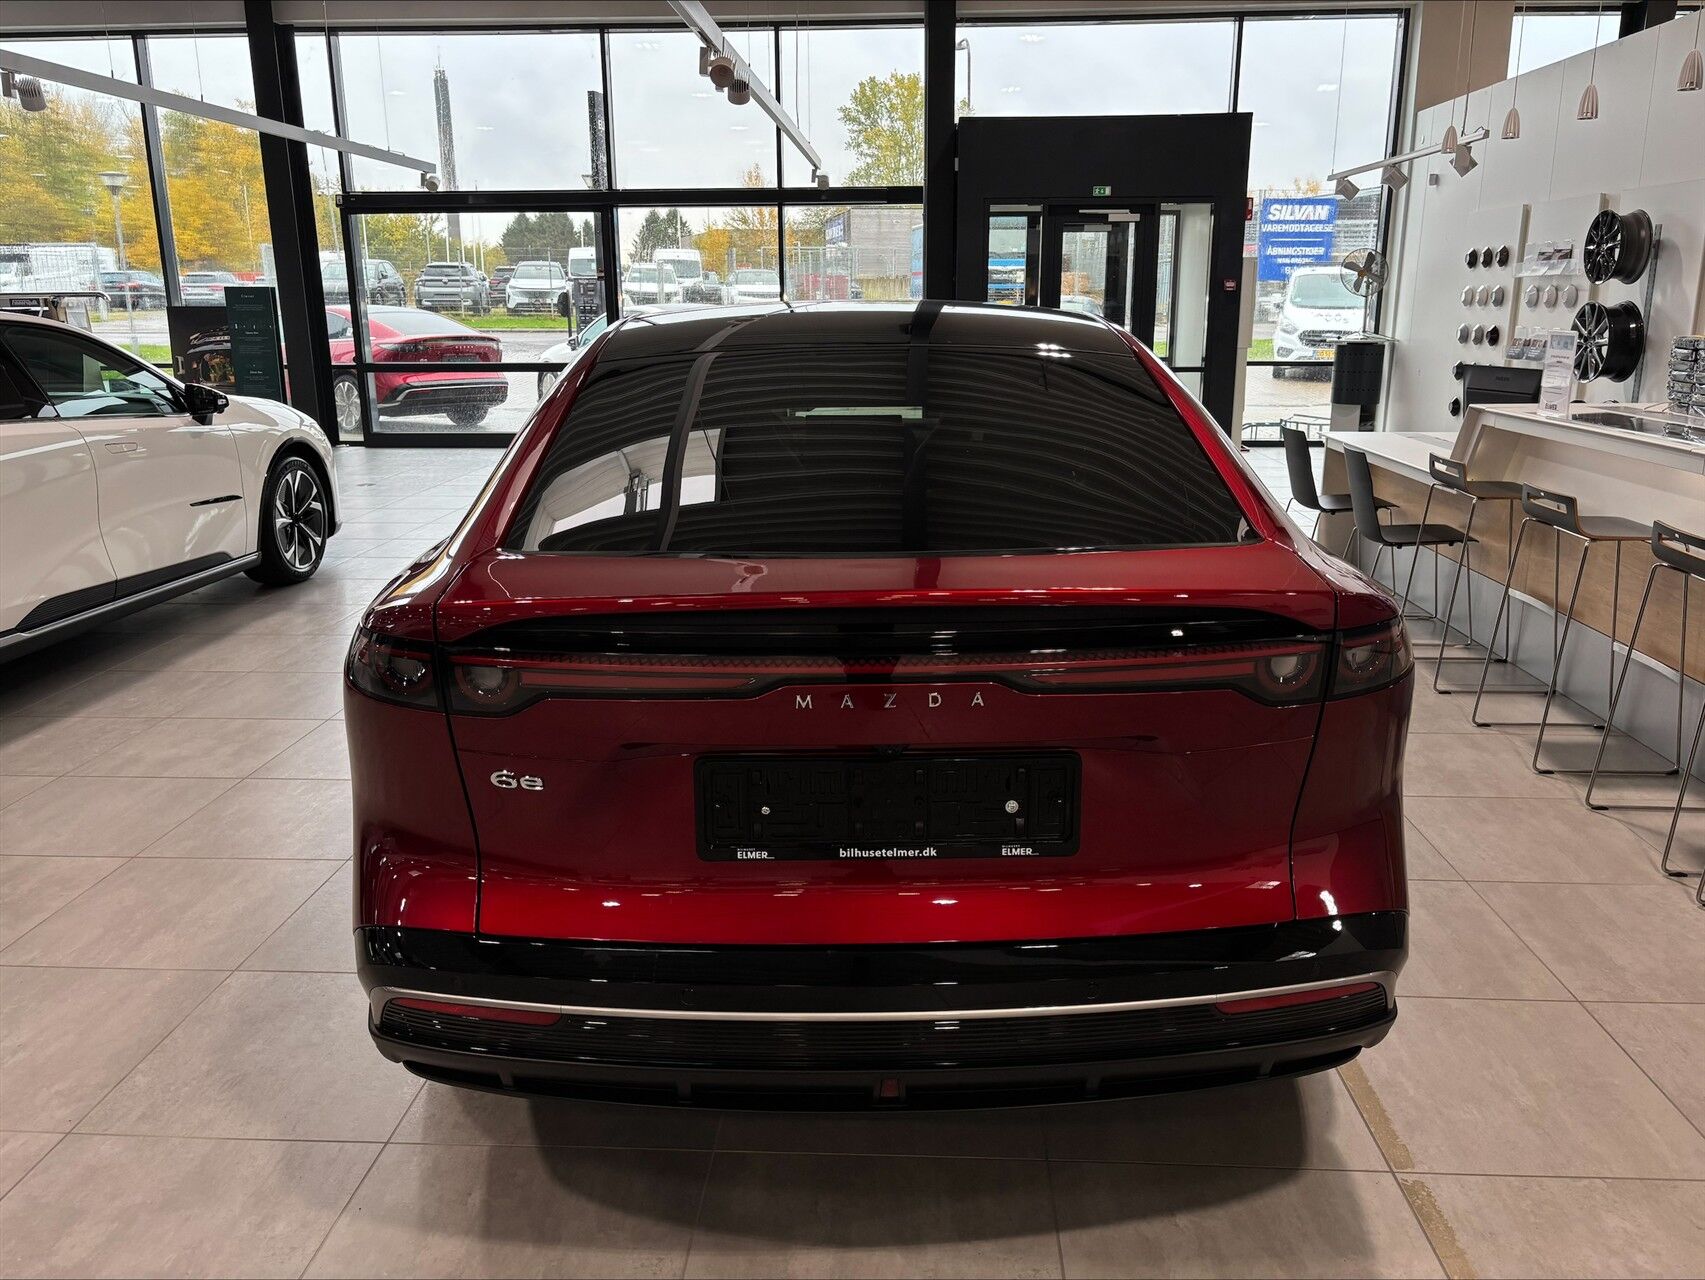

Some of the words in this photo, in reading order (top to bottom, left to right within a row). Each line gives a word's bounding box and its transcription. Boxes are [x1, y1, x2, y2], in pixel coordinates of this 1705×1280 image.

[1268, 204, 1330, 221] SILVAN
[794, 691, 986, 710] MAZDA
[490, 769, 544, 791] 6e
[737, 851, 769, 859] ELMER
[839, 847, 938, 858] bilhusetelmer.dk
[1001, 847, 1033, 856] ELMER
